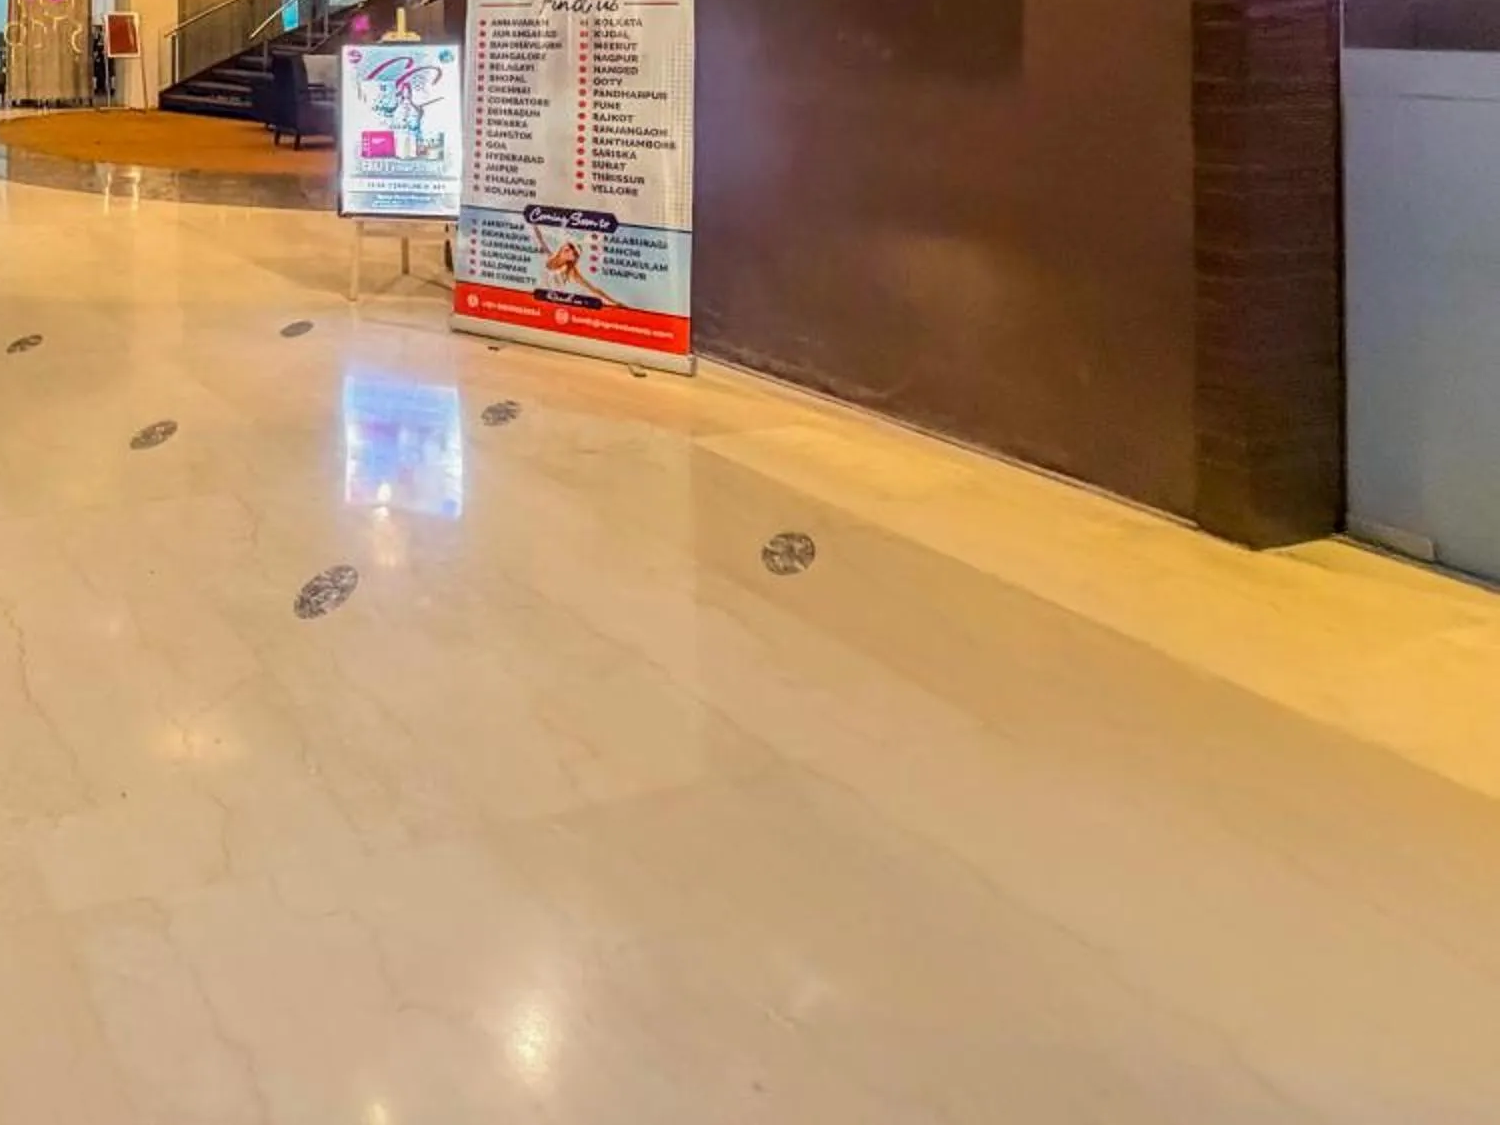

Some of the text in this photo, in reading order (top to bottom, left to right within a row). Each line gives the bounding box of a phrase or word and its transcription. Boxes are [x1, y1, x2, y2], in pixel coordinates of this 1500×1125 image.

[593, 18, 643, 27] KOLKATA
[593, 42, 639, 51] MEERUT
[593, 54, 639, 63] NAGPUR
[489, 74, 528, 83] BHOPAL
[593, 78, 623, 87] OOTY
[593, 88, 668, 100] PANDHARPUR
[593, 100, 621, 110] PUNE
[592, 112, 636, 123] RAJKOT
[485, 140, 508, 150] GOA
[485, 152, 545, 164] HYDERABAD
[485, 163, 519, 173] JAIPUR
[591, 160, 628, 171] SURAT
[591, 172, 645, 185] THRISSUR
[591, 184, 639, 197] VELLORE
[528, 206, 568, 228] Coming
